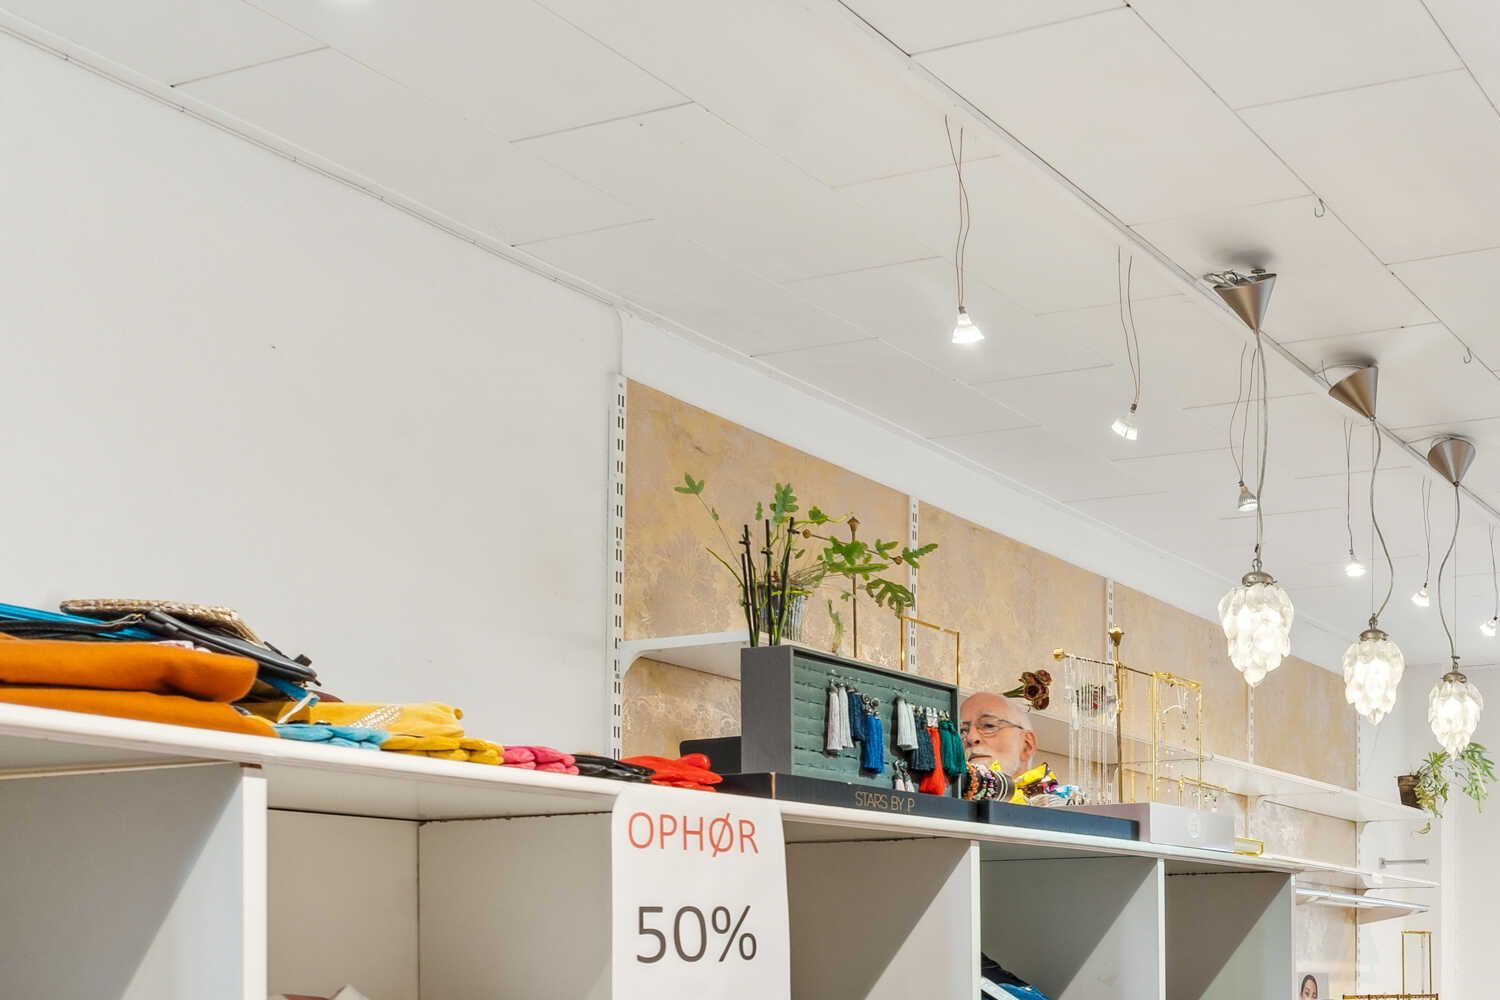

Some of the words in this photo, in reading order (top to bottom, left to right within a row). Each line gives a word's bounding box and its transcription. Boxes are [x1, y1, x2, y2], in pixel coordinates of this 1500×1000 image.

[855, 790, 888, 809] STARS
[890, 795, 905, 812] BY
[627, 811, 759, 858] OPHØR
[636, 904, 757, 964] 50%
